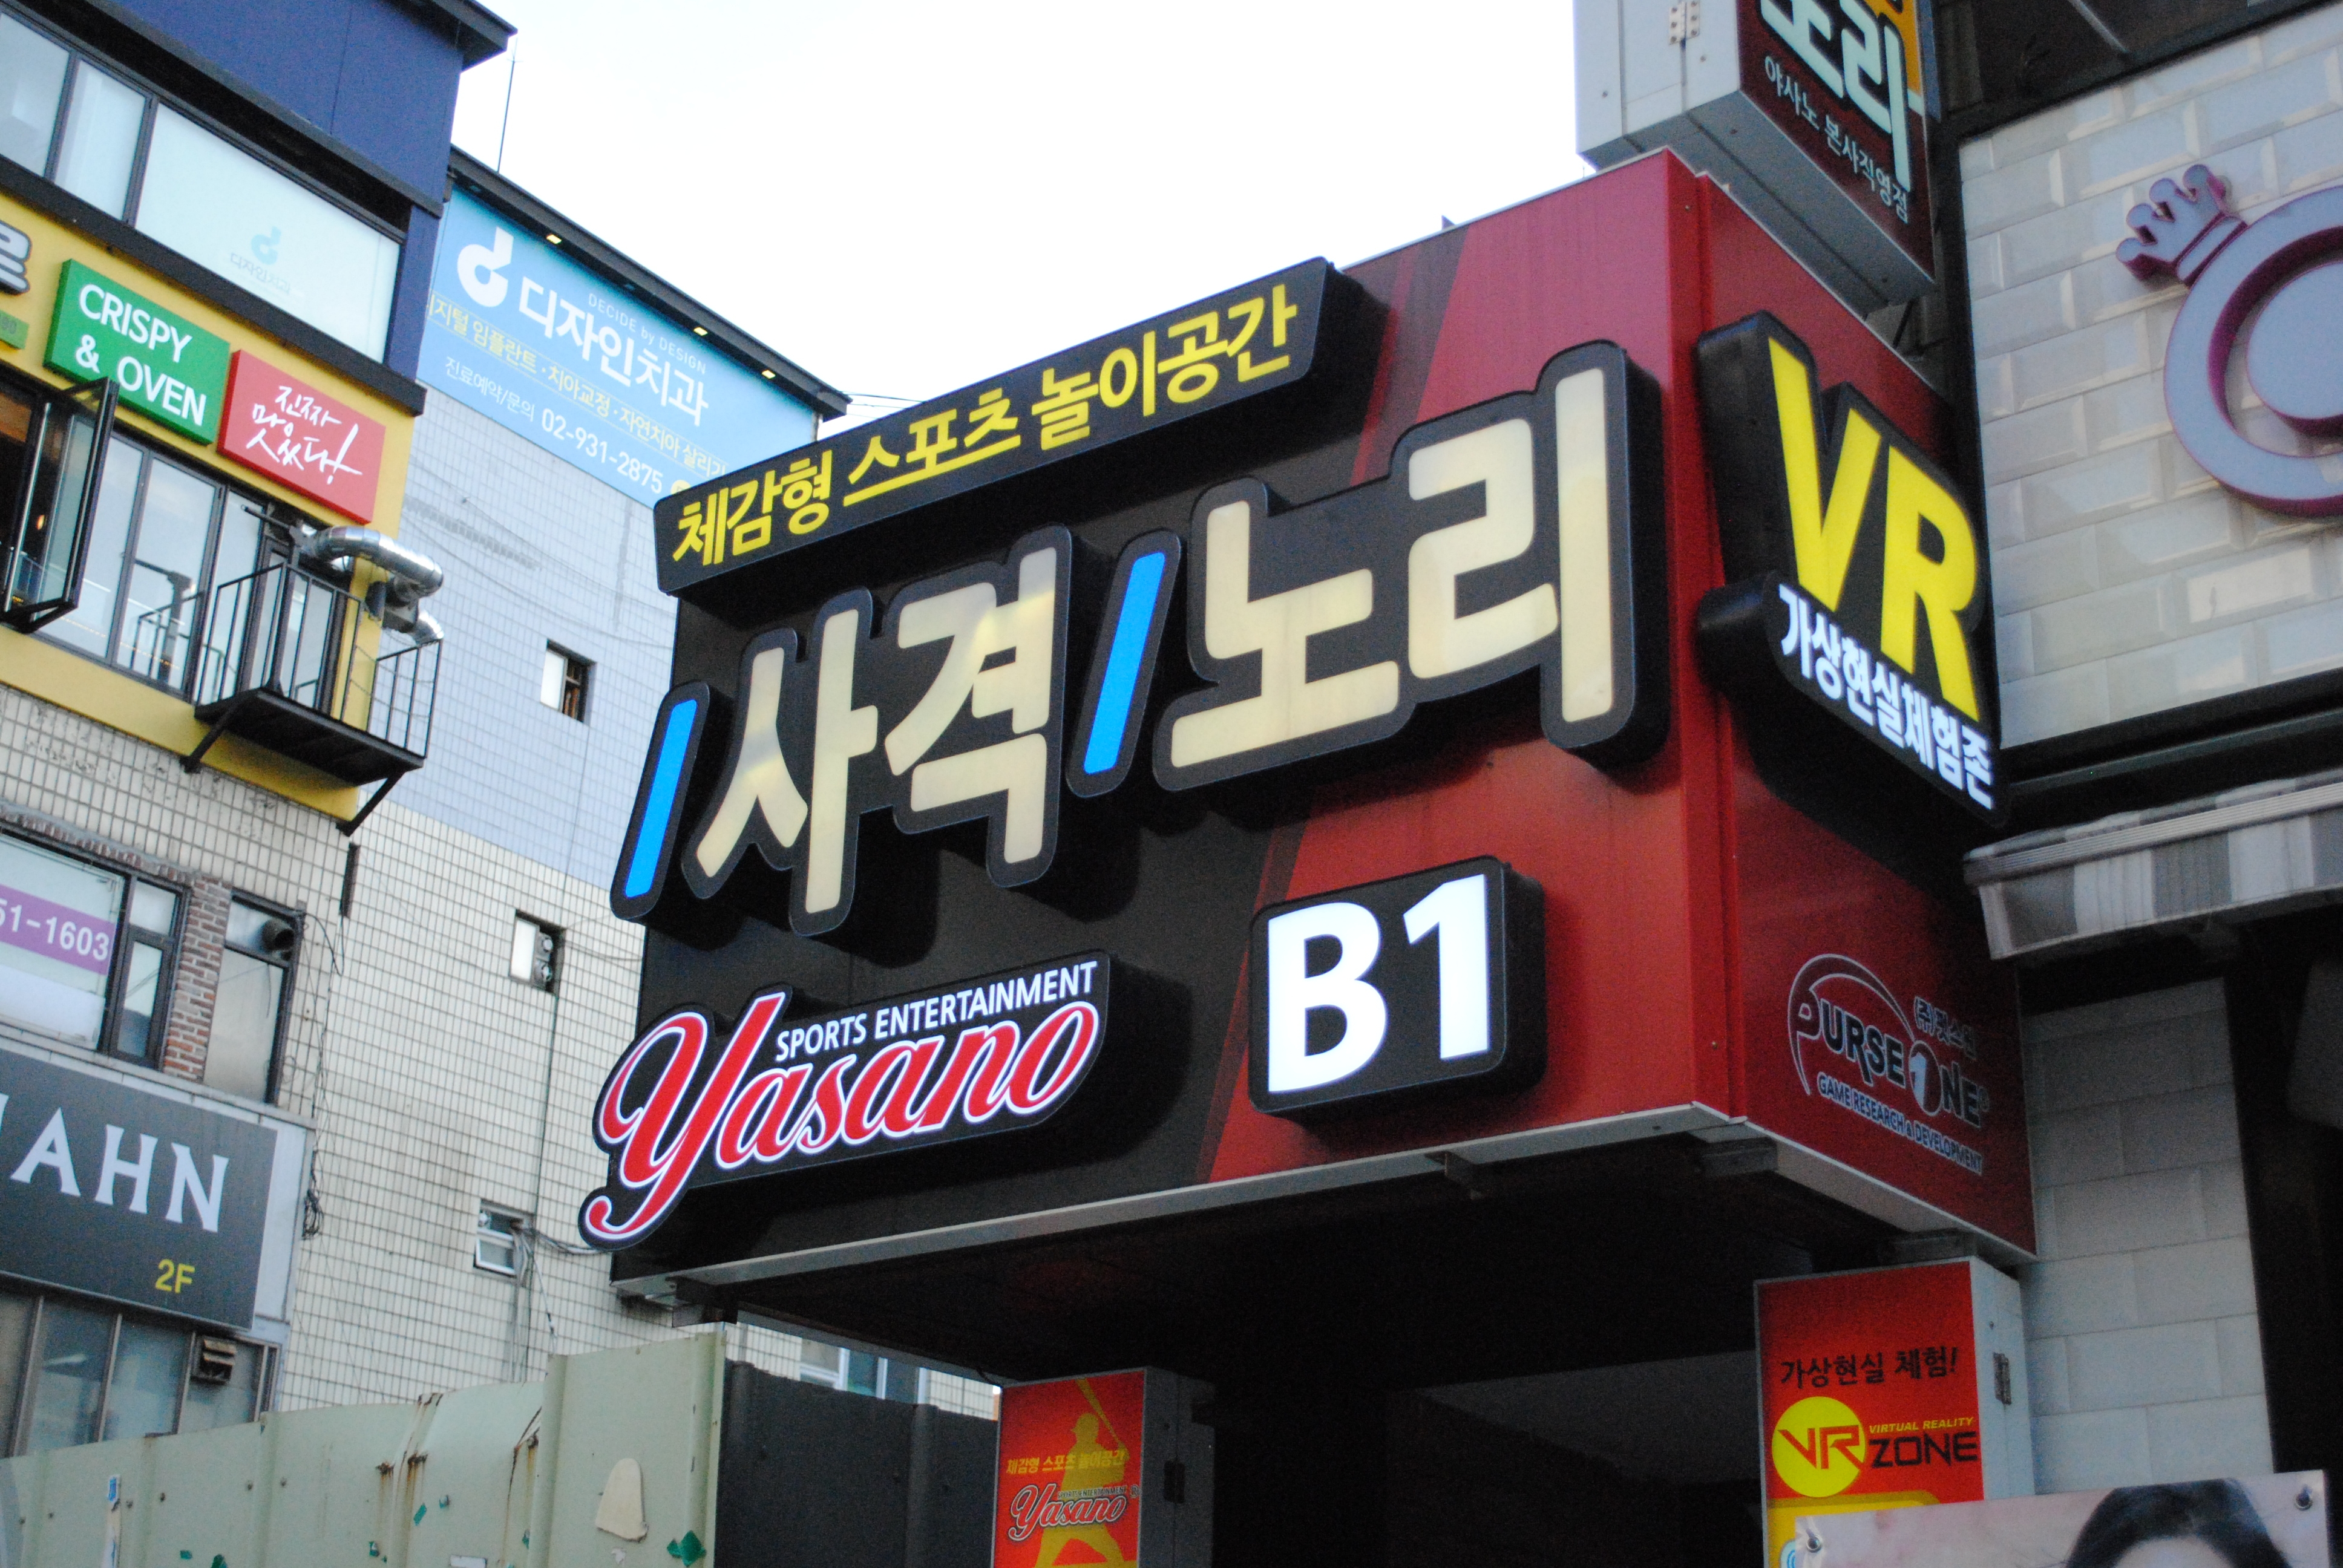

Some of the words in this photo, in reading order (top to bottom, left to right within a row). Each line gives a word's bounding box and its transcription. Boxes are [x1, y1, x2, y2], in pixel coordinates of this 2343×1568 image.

[1764, 55, 1820, 130] 야사노
[1824, 113, 1909, 224] 본사직영점
[79, 284, 192, 363] CRISPY
[518, 275, 709, 427] 디자인치과
[588, 292, 637, 334] DECIDE
[640, 325, 655, 346] by
[659, 335, 708, 375] DESIGN
[75, 334, 100, 374] &
[116, 356, 207, 426] OVEN
[445, 356, 536, 422] 진료예약/문의
[541, 408, 663, 495] 02-931-2875
[471, 319, 538, 375] 임플란트
[548, 367, 611, 418] 치아교정
[620, 408, 681, 459] 자연치아
[682, 442, 726, 477] 살리기
[672, 449, 833, 567] 체감형
[843, 387, 1021, 508] 스포츠
[1031, 283, 1298, 452] 놀이공간
[1768, 336, 1979, 722] VR
[696, 546, 1058, 915] 사격
[1172, 367, 1614, 767] 노리
[1778, 583, 1994, 811] 가상현실체험존
[776, 1011, 868, 1063] SPORTS
[875, 959, 1098, 1042] ENTERTAINMENT
[1268, 874, 1489, 1094] B1
[0, 1093, 229, 1233] AHN
[585, 989, 1100, 1244] Yasano
[1817, 1071, 1853, 1107] GAME
[1853, 1087, 1906, 1134] RESEARCH
[1914, 1123, 1982, 1176] DEVELOPMENT
[156, 1258, 195, 1295] 2F
[1780, 1351, 1884, 1390] 가상현실
[1895, 1346, 1959, 1380] 체험!
[1043, 1454, 1075, 1472] 스포츠
[1777, 1424, 1865, 1471] VR
[1869, 1431, 1978, 1469] ZONE
[1869, 1422, 1919, 1435] VIRTUAL
[1922, 1416, 1975, 1430] REALITY
[1008, 1483, 1127, 1541] Yasano
[1057, 1490, 1080, 1500] SPORTS
[1080, 1485, 1128, 1497] ENTERTAINMENT
